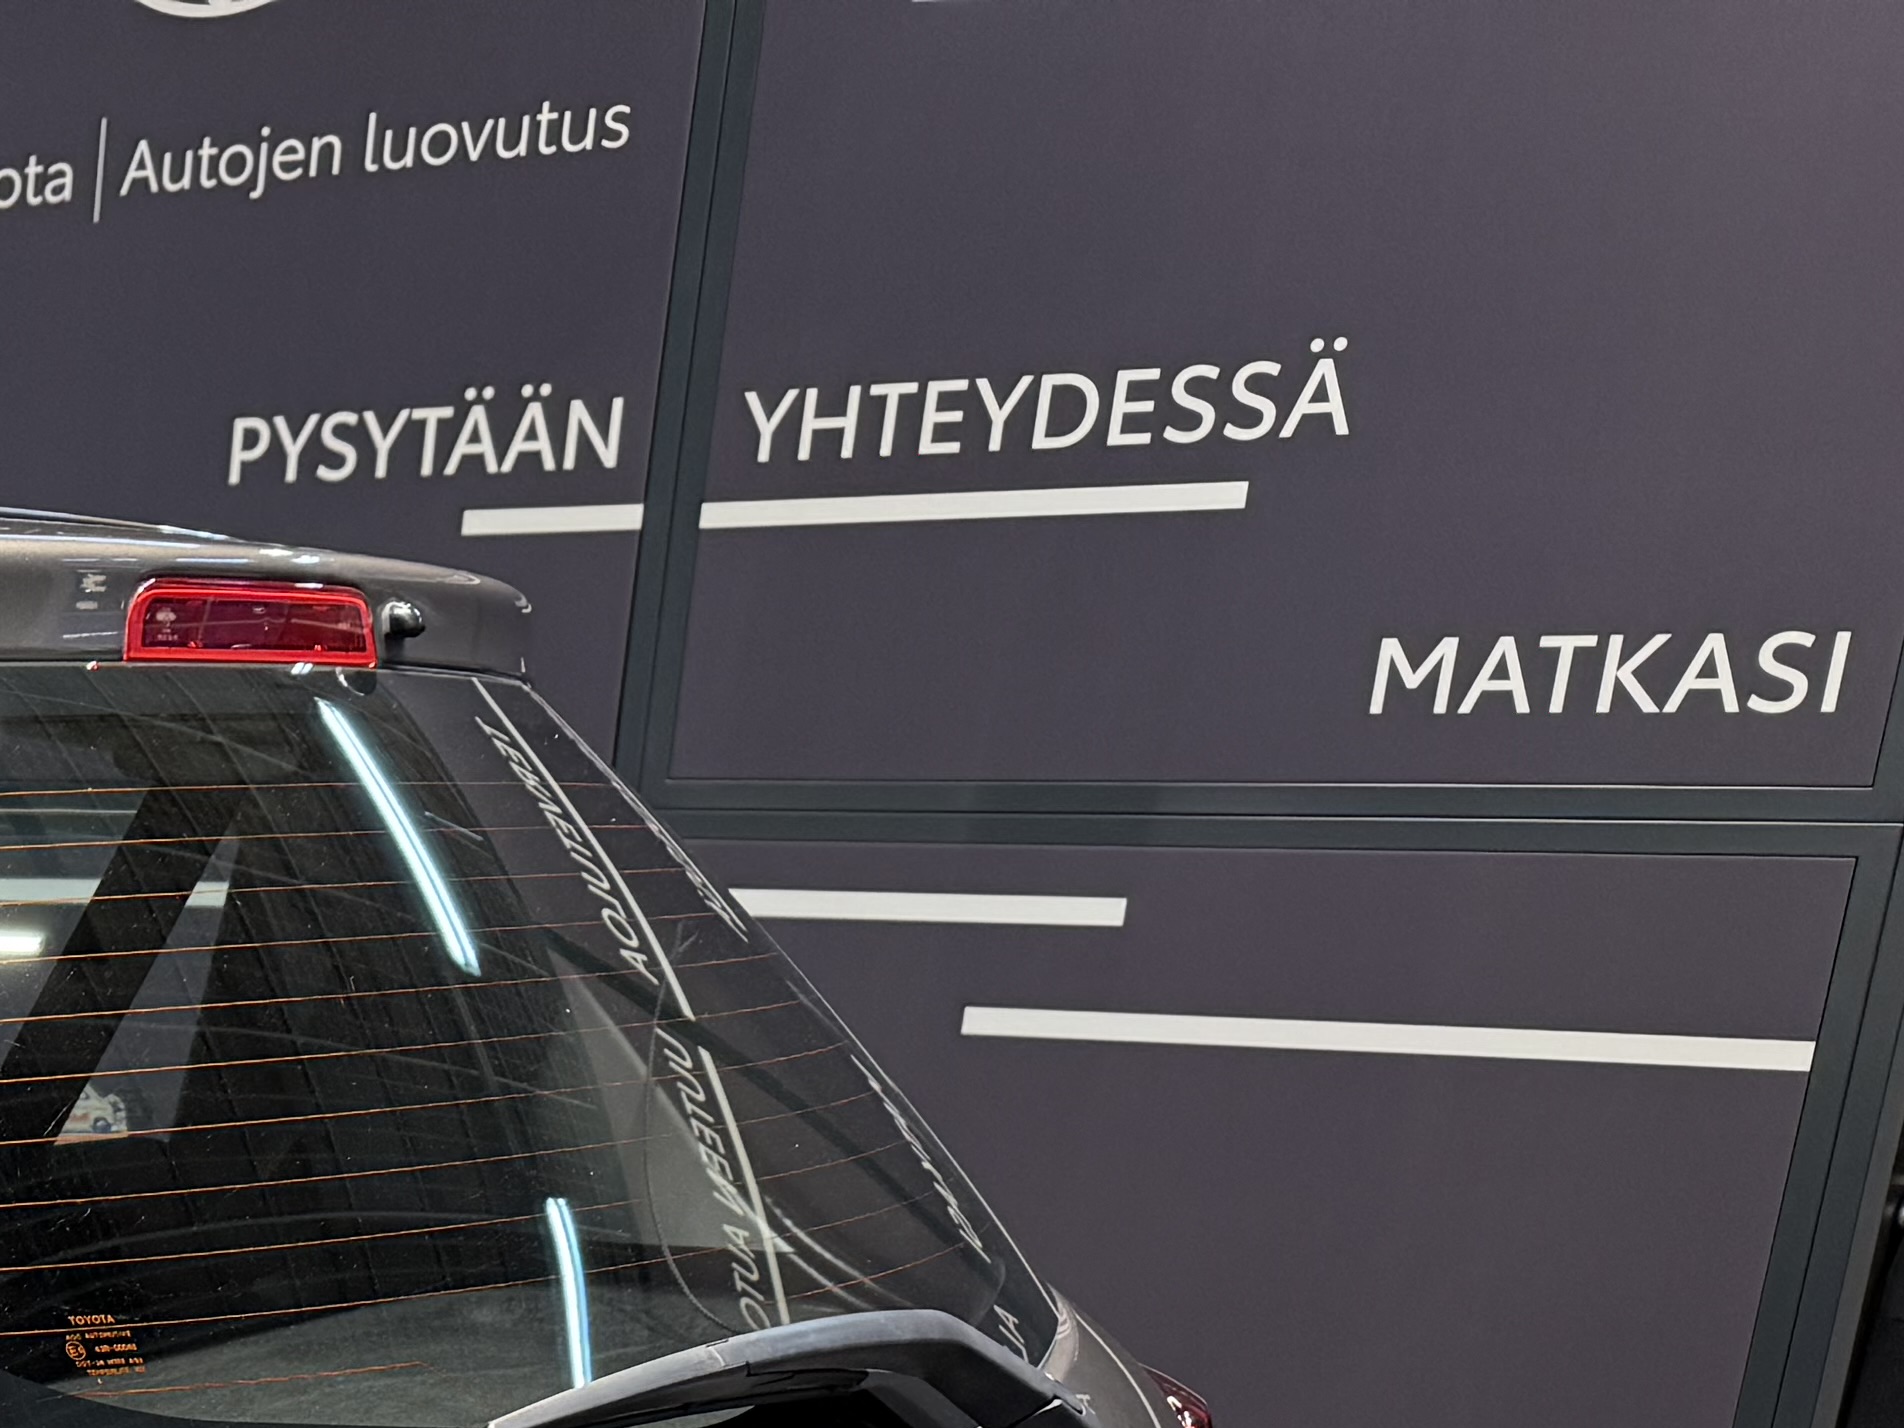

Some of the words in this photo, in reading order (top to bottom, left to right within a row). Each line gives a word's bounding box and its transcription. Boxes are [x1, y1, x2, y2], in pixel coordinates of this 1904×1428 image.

[120, 126, 342, 199] Autojen
[364, 101, 631, 172] luovutus
[227, 384, 625, 486] PYSYTÄÄN
[744, 336, 1351, 465] YHTEYDESSÄ
[1369, 630, 1853, 716] MATKASI
[67, 1314, 116, 1325] TOYOTA
